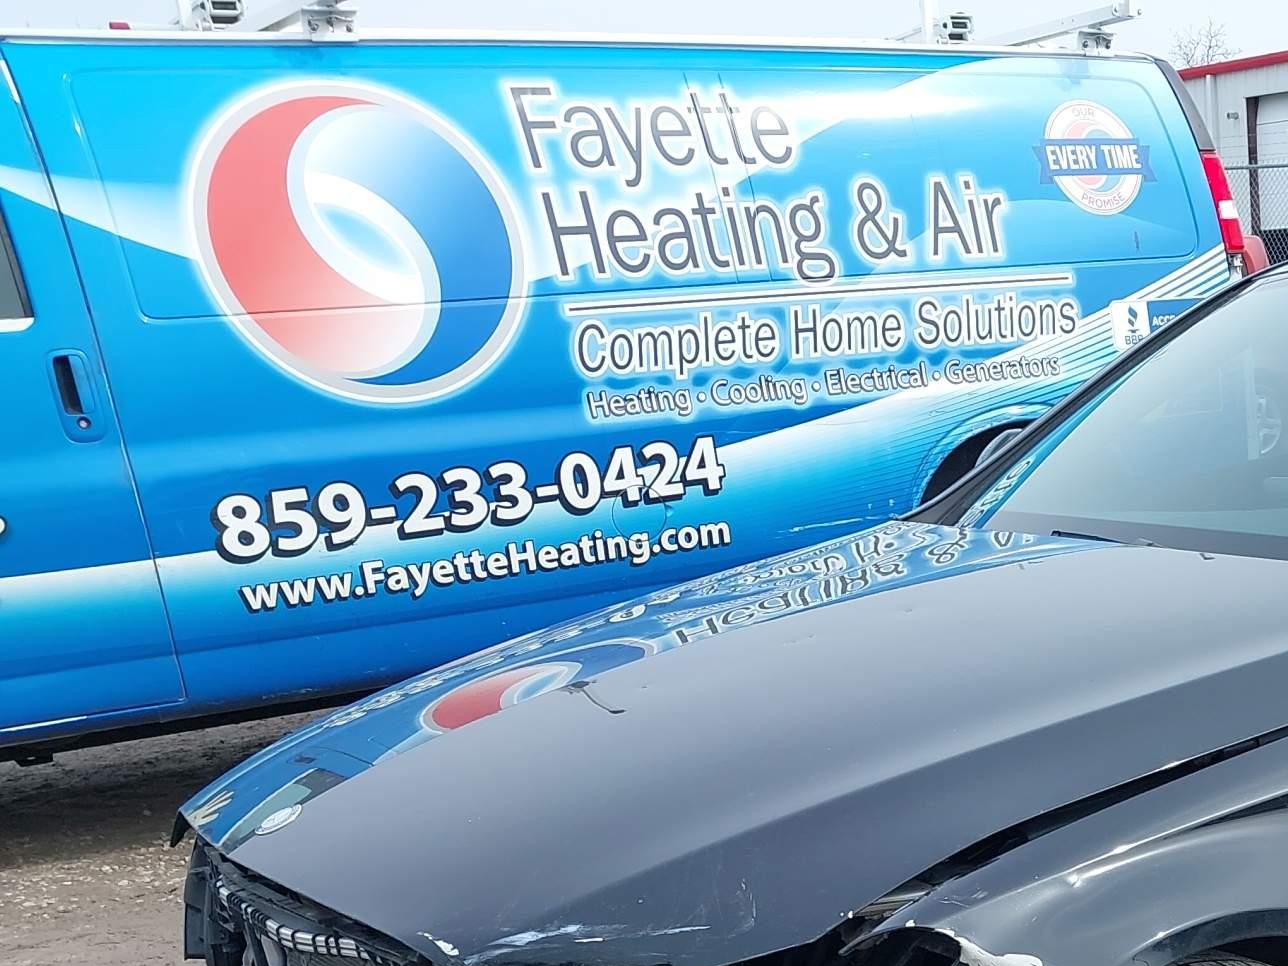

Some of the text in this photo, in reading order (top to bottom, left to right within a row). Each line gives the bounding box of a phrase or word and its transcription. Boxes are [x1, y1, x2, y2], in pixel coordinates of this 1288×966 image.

[509, 86, 793, 188] Fayette
[1045, 144, 1142, 170] EVERY TIME
[541, 179, 1001, 280] Heating & Air
[1081, 192, 1126, 209] PROMISE
[577, 295, 1077, 376] Complete Home Solutions
[586, 354, 1061, 419] Heating Cooling Electrical Generators
[215, 436, 725, 562] 859-233-0424
[240, 519, 732, 611] www.FayetteHeating.com
